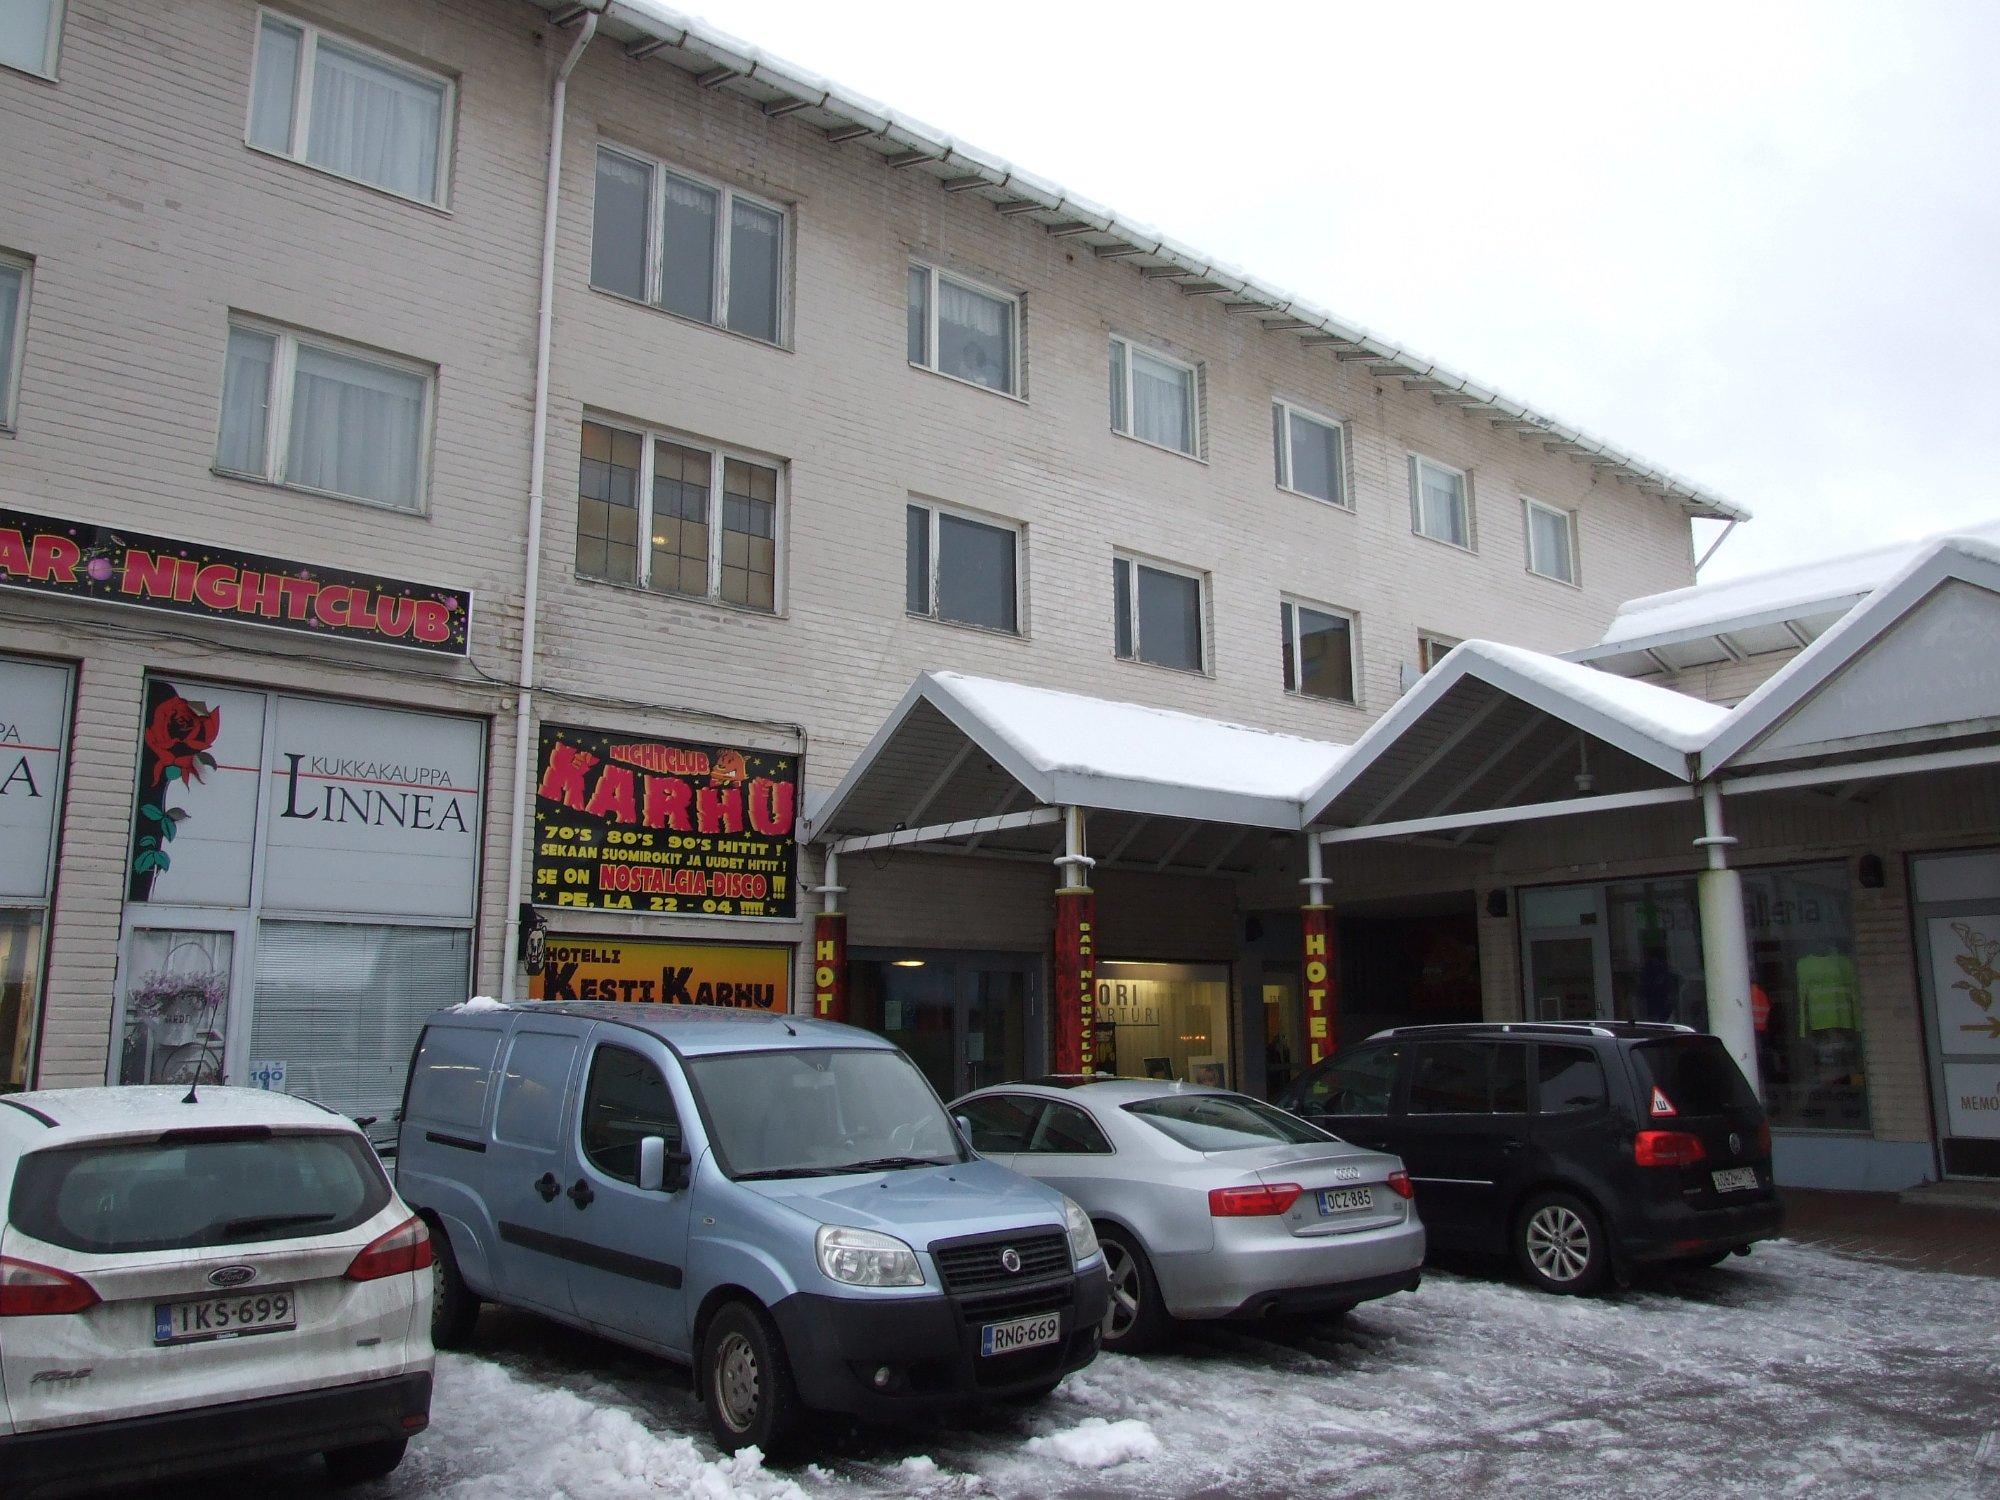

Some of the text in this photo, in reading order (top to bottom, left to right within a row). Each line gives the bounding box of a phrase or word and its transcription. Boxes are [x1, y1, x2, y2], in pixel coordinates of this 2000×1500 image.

[121, 549, 451, 643] NIGHTCLUB
[311, 755, 452, 787] KUKKAKAUPPA
[610, 744, 710, 776] NIGHTCLUB
[281, 753, 469, 833] LINNEA
[538, 741, 794, 835] KARHU
[545, 826, 592, 841] 70'S
[607, 831, 653, 846] 80'S
[668, 838, 711, 851] 90'S
[718, 840, 769, 855] HITIT
[541, 844, 597, 859] SEKAAN
[602, 848, 682, 866] SUOMIROKIT
[686, 854, 701, 867] JA
[705, 856, 744, 870] UUDET
[748, 859, 779, 872] HITIT
[537, 868, 557, 885] SE
[564, 868, 590, 885] ON
[599, 864, 767, 900] NOSTALGIA-DISCO
[604, 894, 633, 910] LA
[650, 897, 678, 911] 22
[702, 901, 732, 914] 04
[1079, 922, 1092, 955] BAR
[545, 947, 621, 964] HOTELLI
[544, 961, 775, 1008] KESTI KARHU
[1080, 970, 1094, 1076] NIGHTCLUB
[219, 1268, 245, 1285] Ford
[181, 1292, 290, 1332] IKS-699
[994, 1318, 1057, 1349] RNG-669
